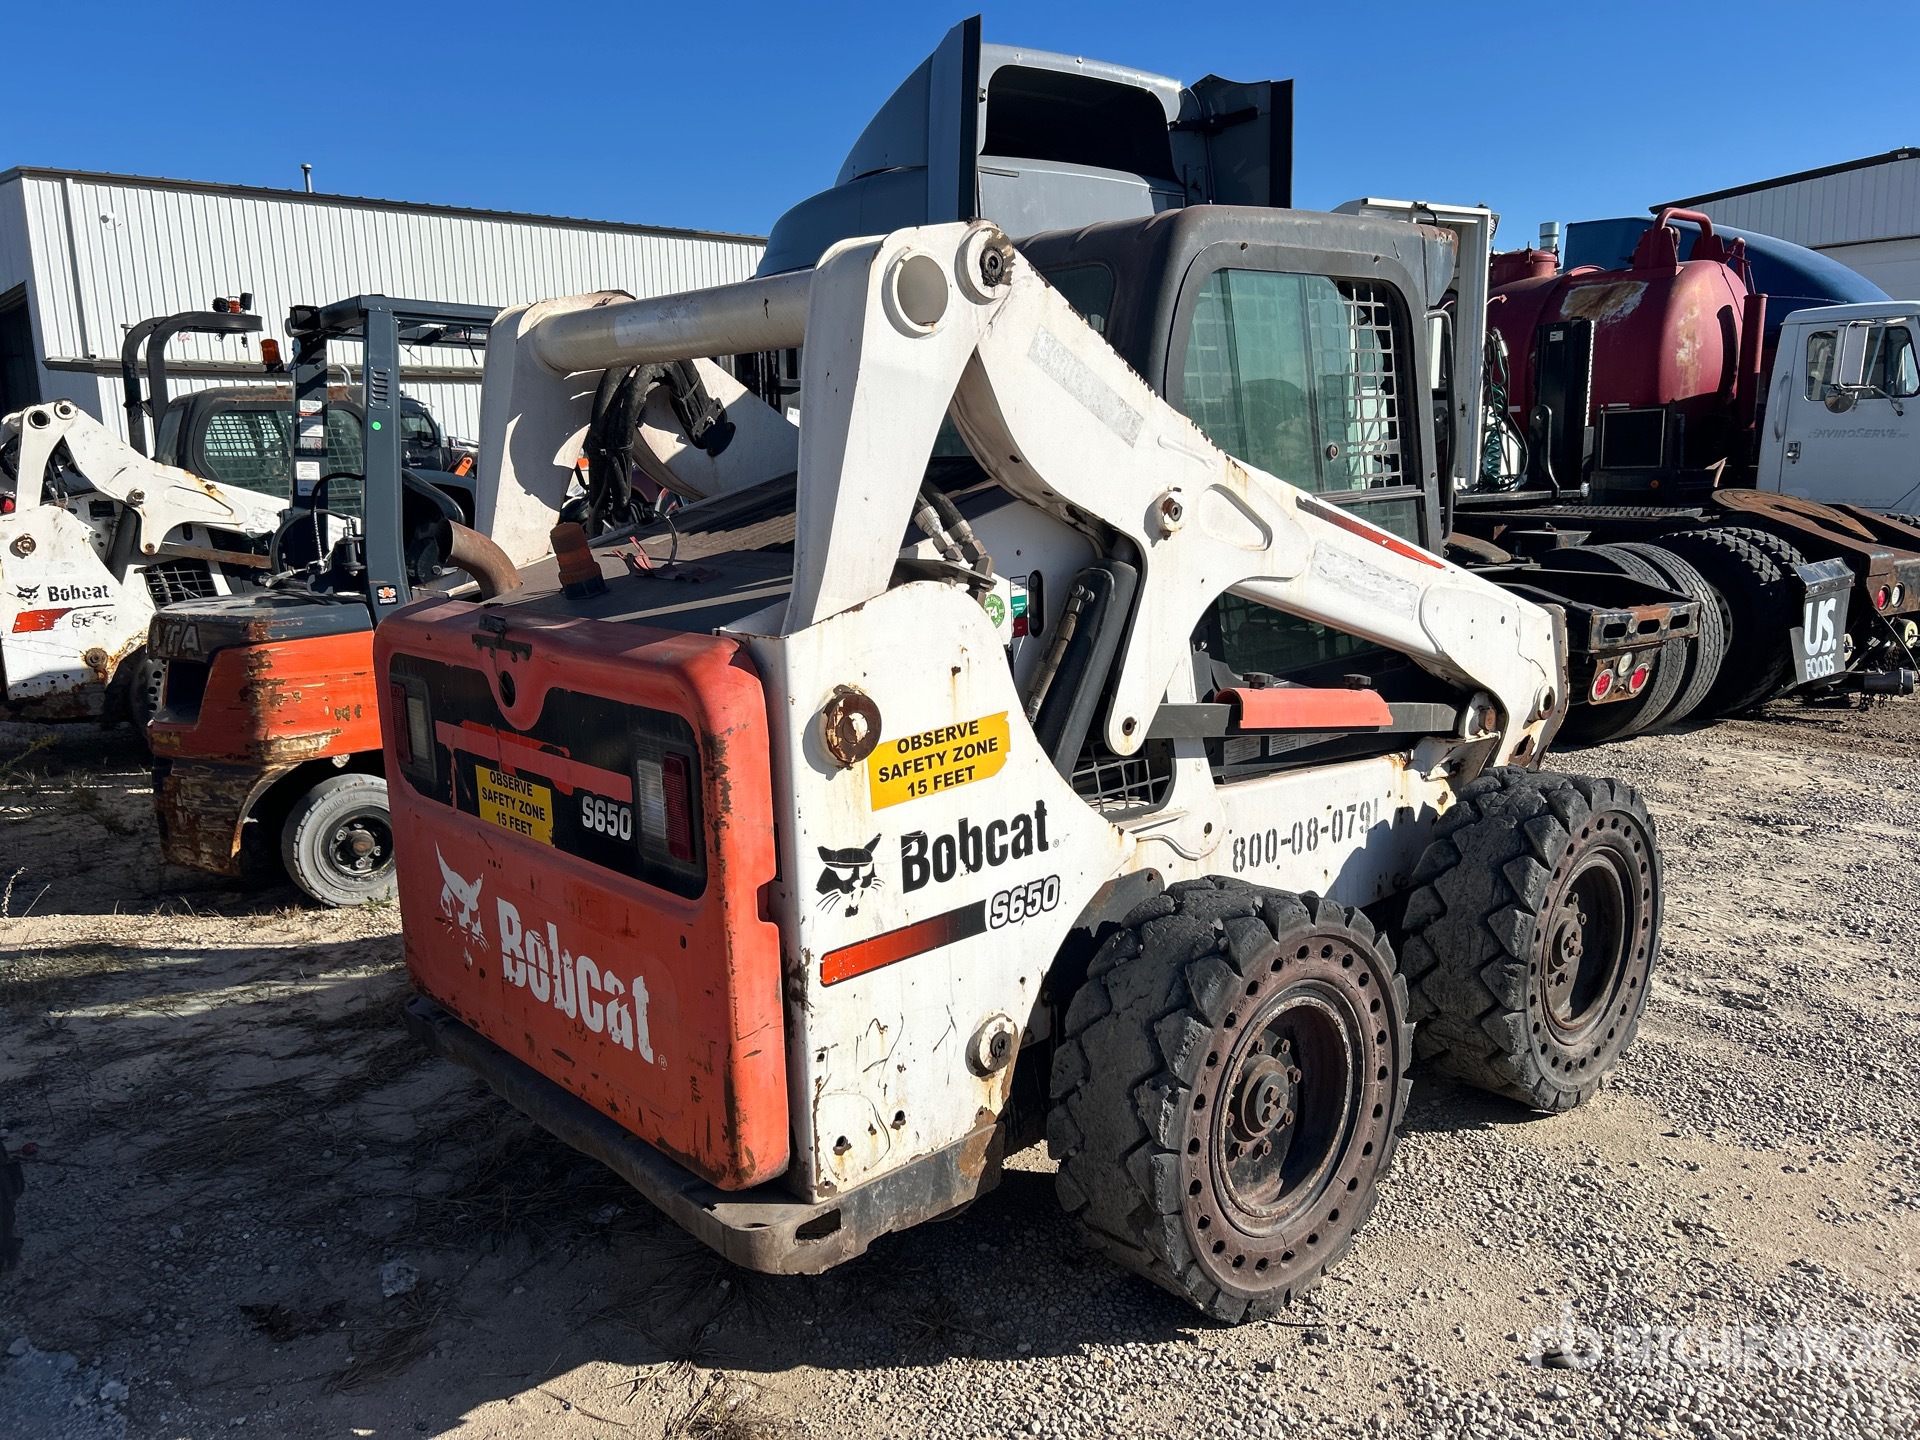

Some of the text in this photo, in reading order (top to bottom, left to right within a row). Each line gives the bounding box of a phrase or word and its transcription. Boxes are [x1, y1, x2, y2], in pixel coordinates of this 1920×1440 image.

[47, 585, 110, 602] Bobcat
[1805, 653, 1836, 680] FOODS
[897, 719, 980, 754] OBSERVE
[878, 736, 999, 783] SAFETY ZONE
[489, 770, 534, 798] OBSERVE
[907, 764, 976, 798] 15 FEET
[481, 786, 546, 822] SAFETY ZONE
[582, 795, 632, 841] S650
[496, 810, 533, 836] 15 FEET
[900, 799, 1050, 894] Bobcat
[989, 874, 1061, 929] S650
[496, 896, 654, 1064] Bobcat
